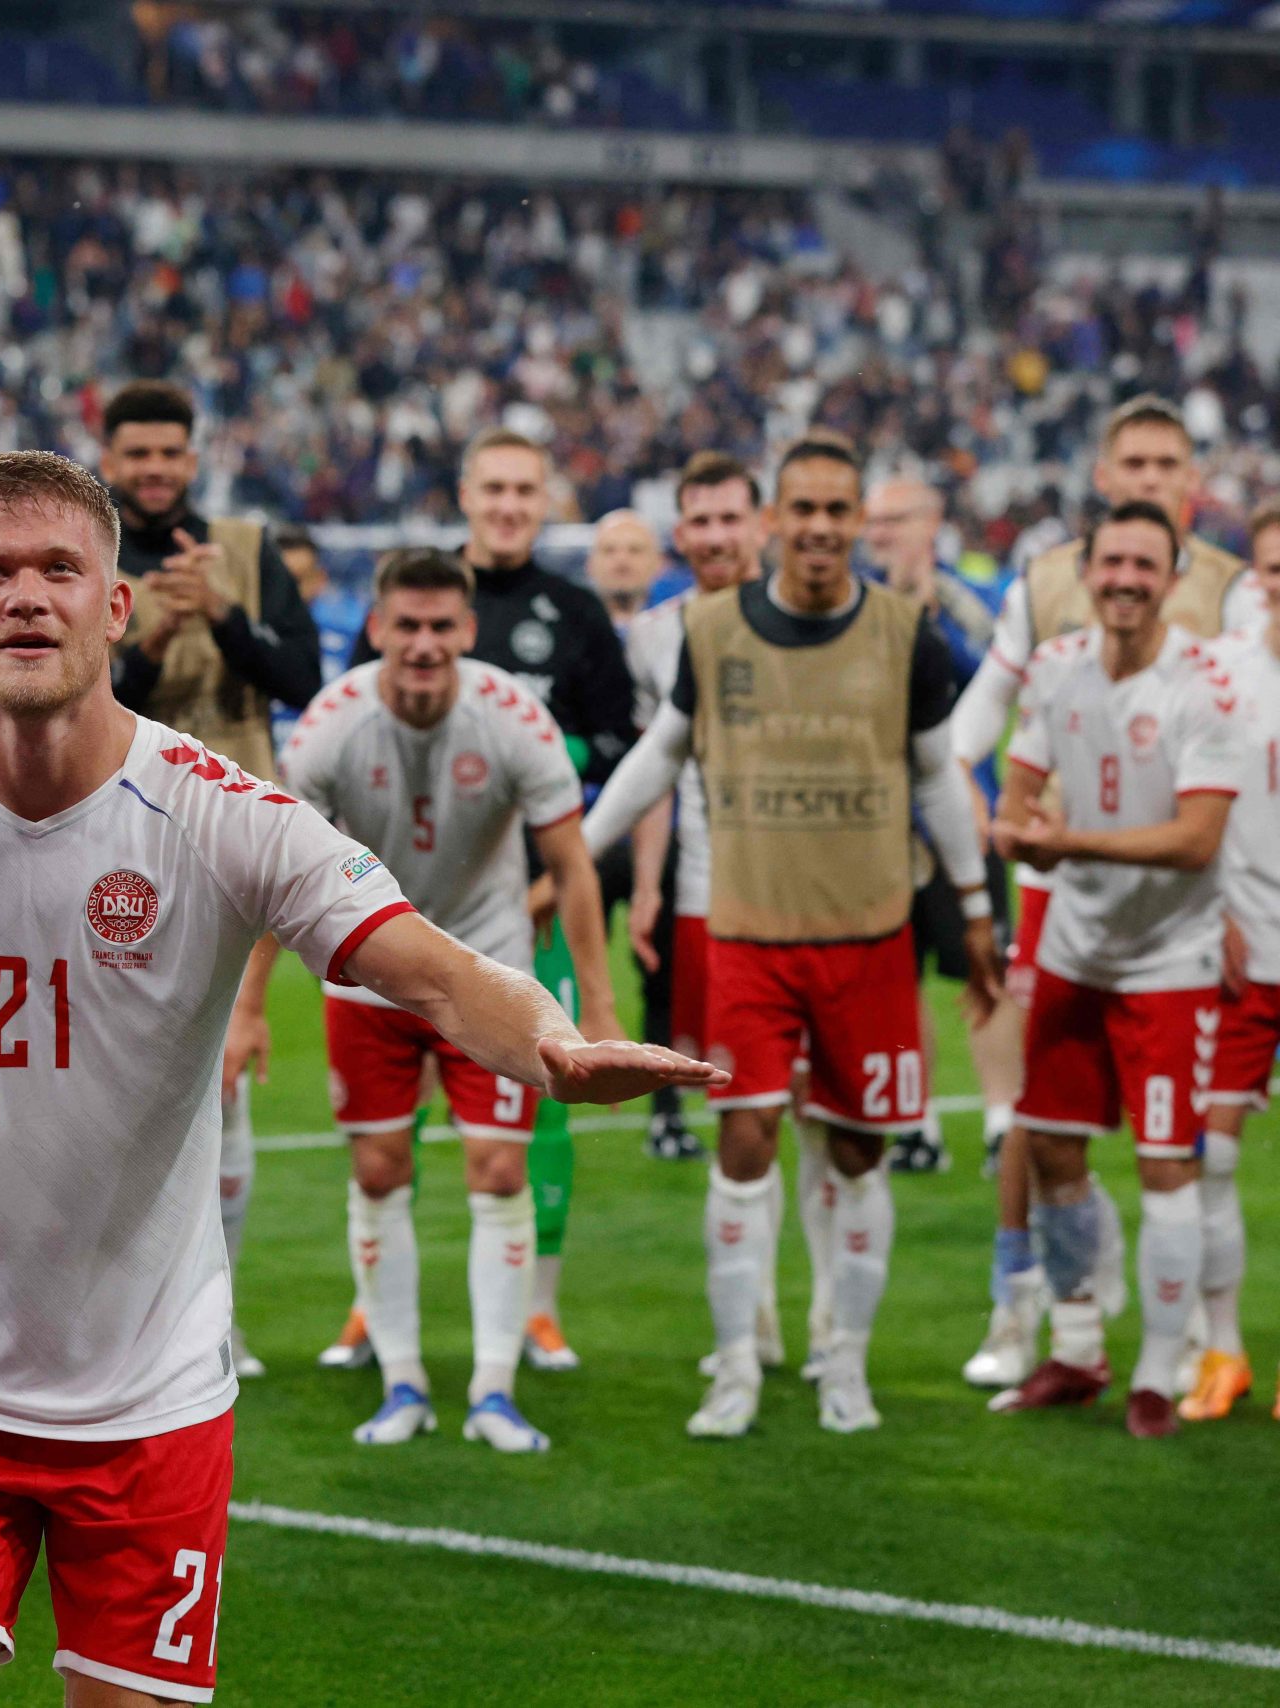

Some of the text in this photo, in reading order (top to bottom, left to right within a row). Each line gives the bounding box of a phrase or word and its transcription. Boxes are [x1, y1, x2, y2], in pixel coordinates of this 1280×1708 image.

[1099, 753, 1119, 815] 8
[412, 795, 435, 852] 5
[88, 890, 106, 933] DANSK
[102, 895, 145, 917] DBU
[92, 950, 115, 960] FRANCE
[124, 952, 153, 961] DENMARK
[108, 932, 138, 942] 1889
[494, 1074, 524, 1123] 5
[862, 1050, 922, 1117] 20
[1144, 1074, 1174, 1141] 8
